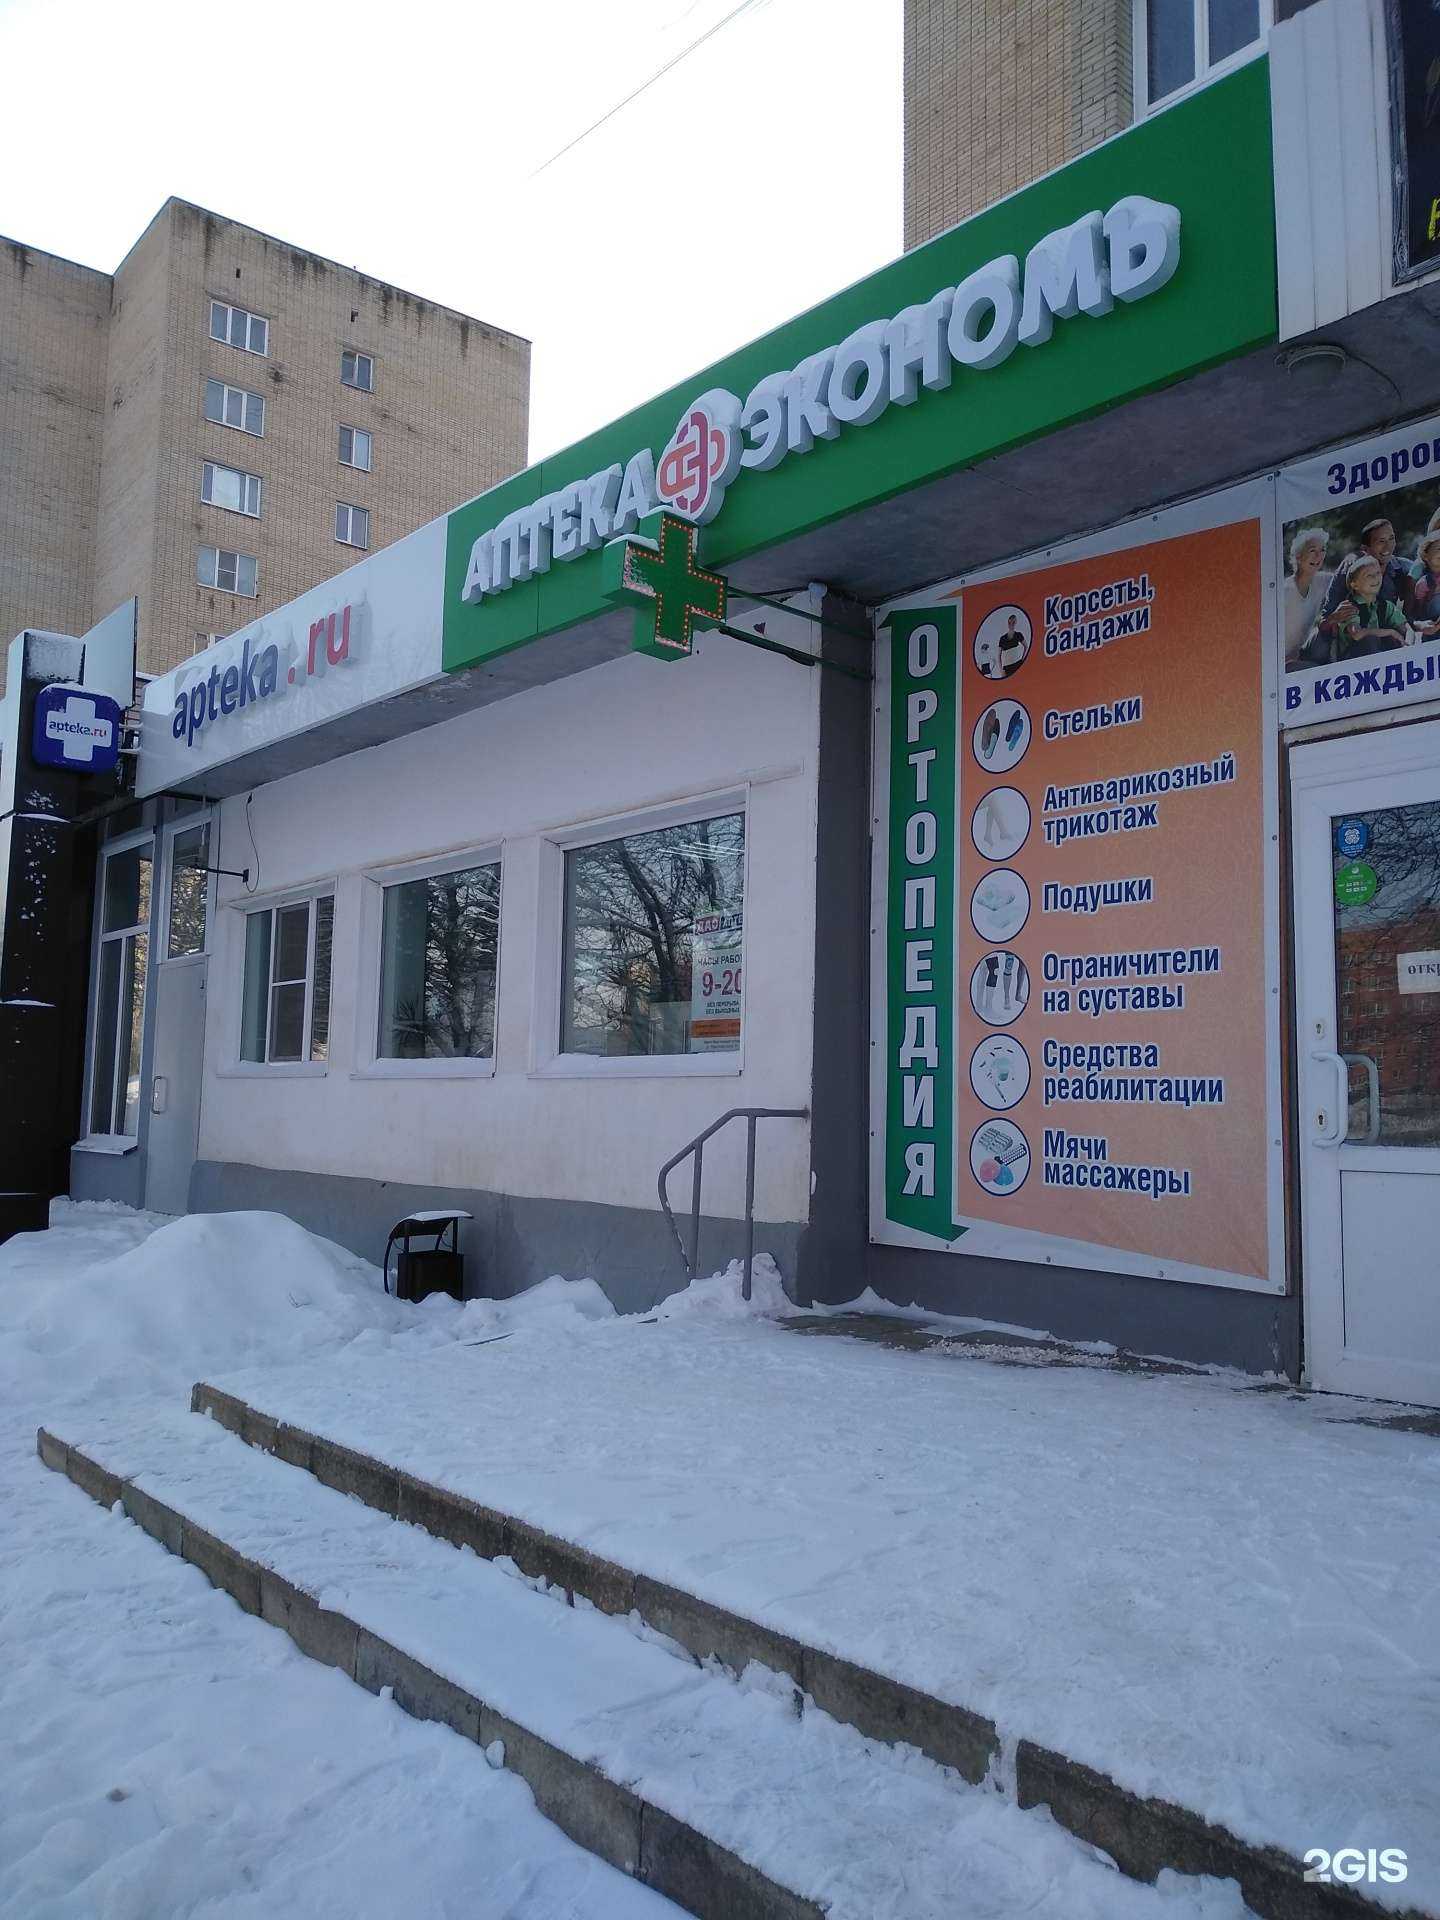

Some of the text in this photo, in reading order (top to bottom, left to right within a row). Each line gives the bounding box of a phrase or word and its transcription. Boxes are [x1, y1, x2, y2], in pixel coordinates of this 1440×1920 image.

[462, 197, 1180, 605] АПТЕКА ЭКОНОМЬ
[1046, 576, 1153, 625] Корсеты,
[1046, 607, 1149, 655] бандажи
[172, 604, 352, 748] apteka.ru
[1286, 685, 1302, 710] в
[49, 721, 107, 737] apteka.ru
[1045, 698, 1141, 738] Стельки
[1043, 754, 1234, 811] Антиварикозный
[1044, 803, 1158, 845] трикотаж
[900, 623, 940, 1196] ОРТОПЕДИЯ
[1044, 878, 1151, 912] Подушки
[1043, 948, 1219, 985] Ограничители
[1043, 985, 1183, 1017] на суставы
[1043, 1040, 1158, 1073] Средства
[1045, 1072, 1223, 1106] реабилитации
[1045, 1130, 1106, 1160] Мячи
[1045, 1163, 1190, 1198] массажеры
